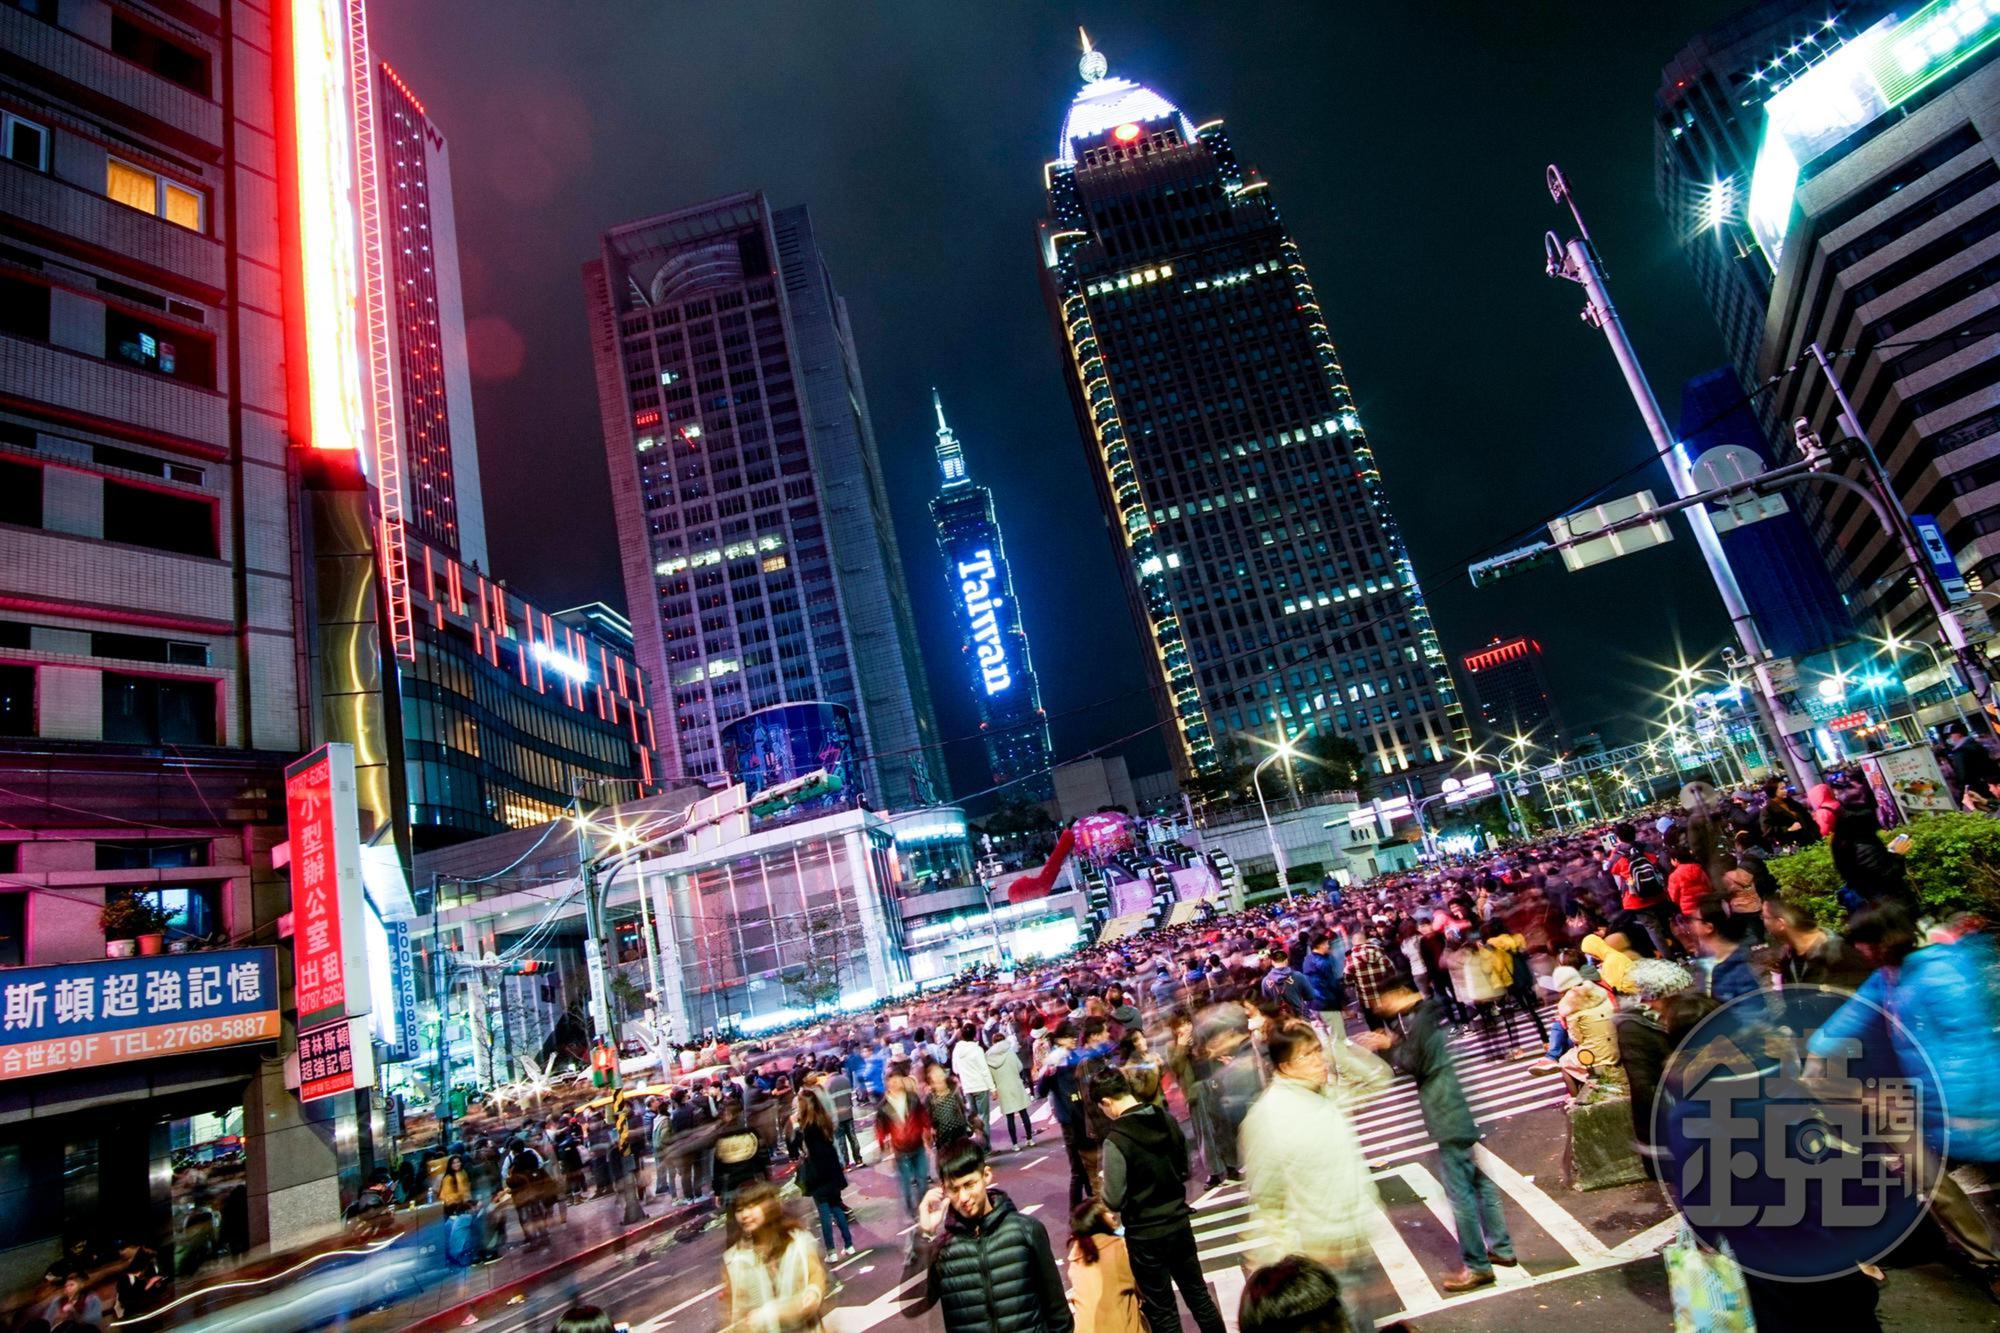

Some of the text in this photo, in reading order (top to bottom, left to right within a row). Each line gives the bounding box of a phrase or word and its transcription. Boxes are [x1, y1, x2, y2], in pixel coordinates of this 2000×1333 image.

[958, 549, 1012, 696] Taiwan
[300, 791, 330, 955] 小型辦公室
[301, 951, 341, 991] 出租
[3, 962, 261, 1031] 斯頓超強記憶
[300, 982, 344, 1012] 8787-6262
[109, 1016, 267, 1056] TEL:2768-5887
[299, 1026, 349, 1060] 普林斯頓
[301, 1050, 351, 1082] 超強記憶
